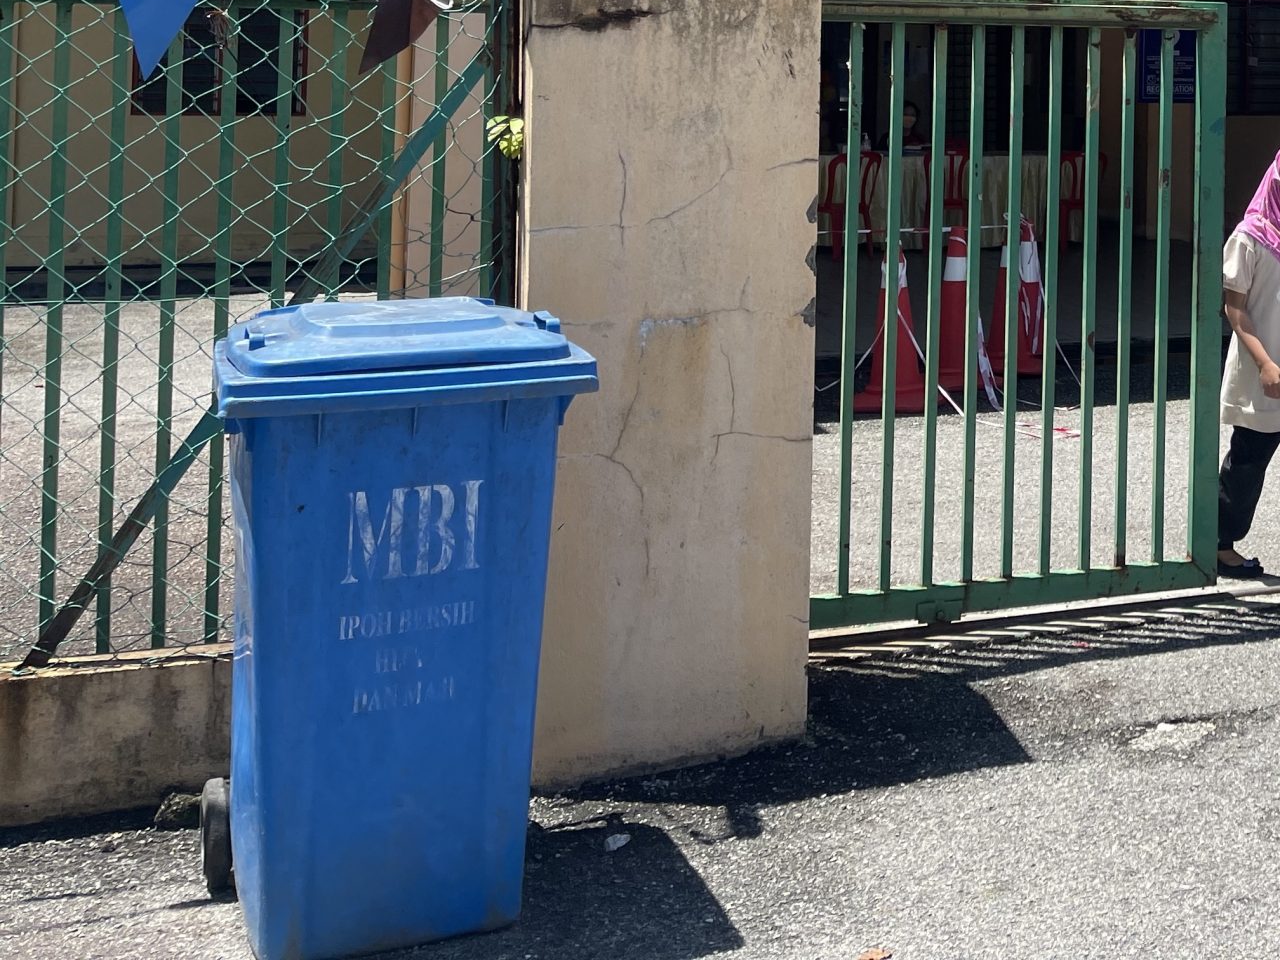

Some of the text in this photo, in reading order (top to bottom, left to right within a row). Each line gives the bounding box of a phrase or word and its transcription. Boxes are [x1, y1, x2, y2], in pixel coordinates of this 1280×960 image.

[1146, 85, 1194, 94] REGATION
[340, 479, 486, 586] MBI
[338, 610, 393, 642] IPOH
